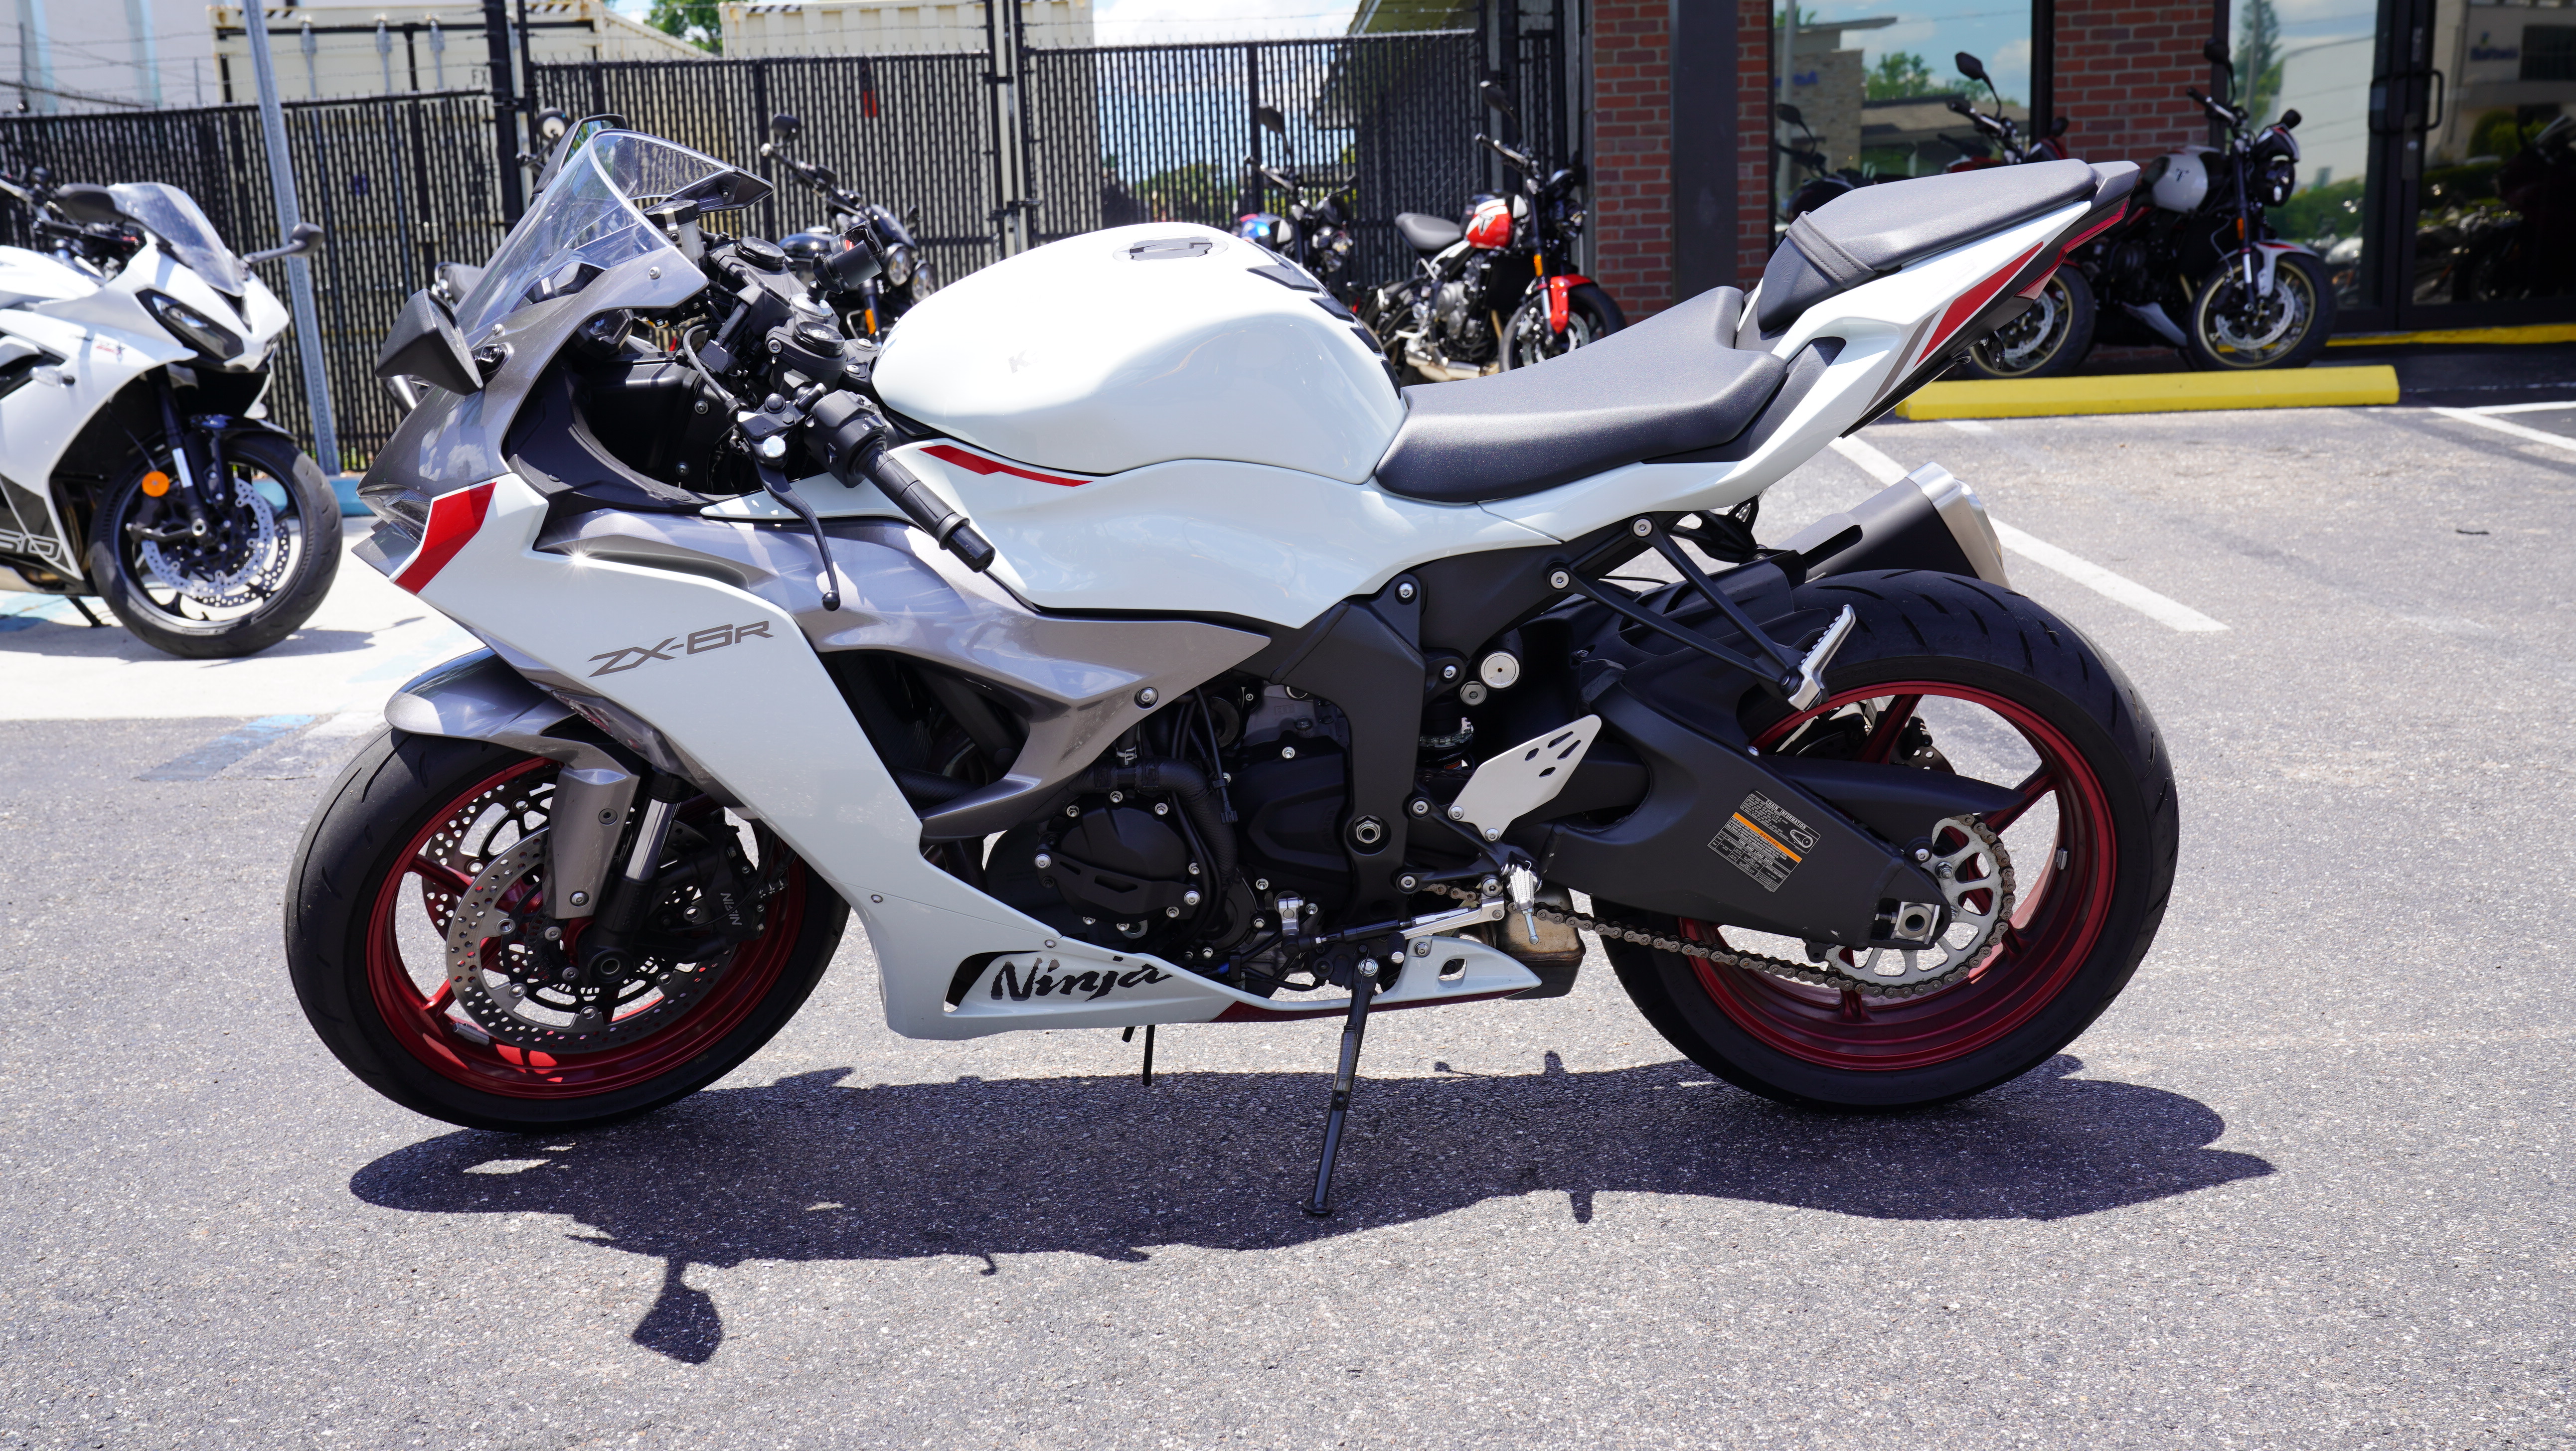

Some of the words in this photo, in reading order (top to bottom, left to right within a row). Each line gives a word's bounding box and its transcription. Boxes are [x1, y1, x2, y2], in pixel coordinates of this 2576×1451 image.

[827, 442, 837, 451] PASS
[587, 620, 775, 678] ZX-6R
[1765, 799, 1779, 811] CHAIN
[1779, 809, 1806, 830] INFORMATION
[1759, 832, 1779, 847] WARNING
[1754, 850, 1765, 859] LOAD
[990, 956, 1174, 1002] Ninja
